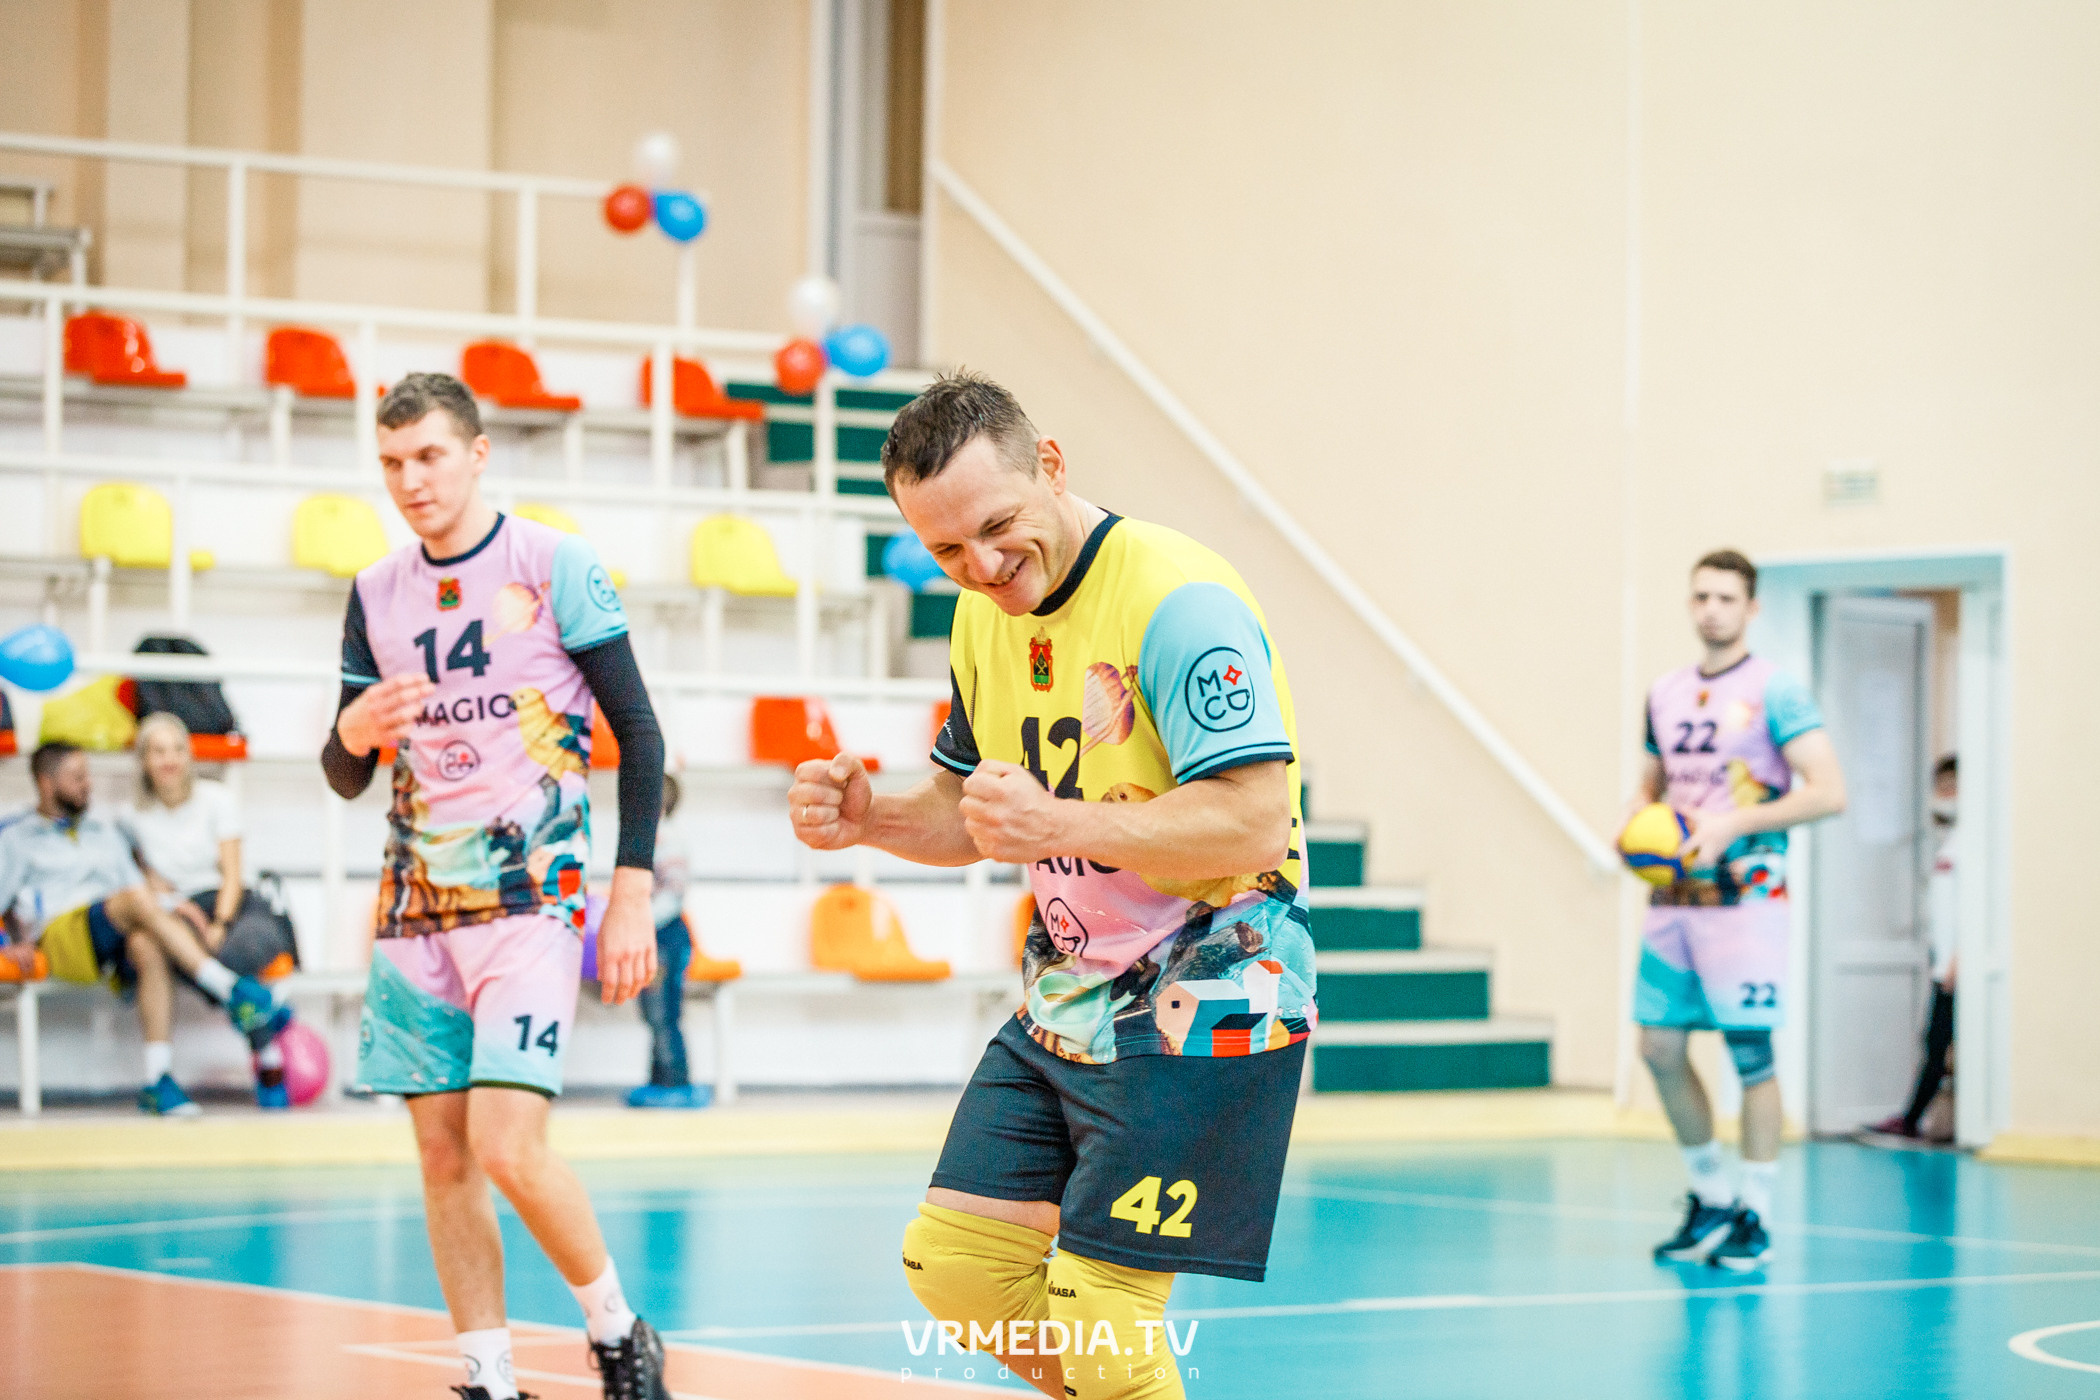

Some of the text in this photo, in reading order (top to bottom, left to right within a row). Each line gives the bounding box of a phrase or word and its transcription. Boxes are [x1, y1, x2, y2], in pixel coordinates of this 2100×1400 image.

[413, 619, 491, 684] 14
[1020, 716, 1084, 801] 42
[1672, 720, 1718, 754] 22
[1740, 981, 1777, 1008] 22
[513, 1014, 560, 1057] 14
[1110, 1175, 1198, 1238] 42
[902, 1253, 924, 1271] KASA
